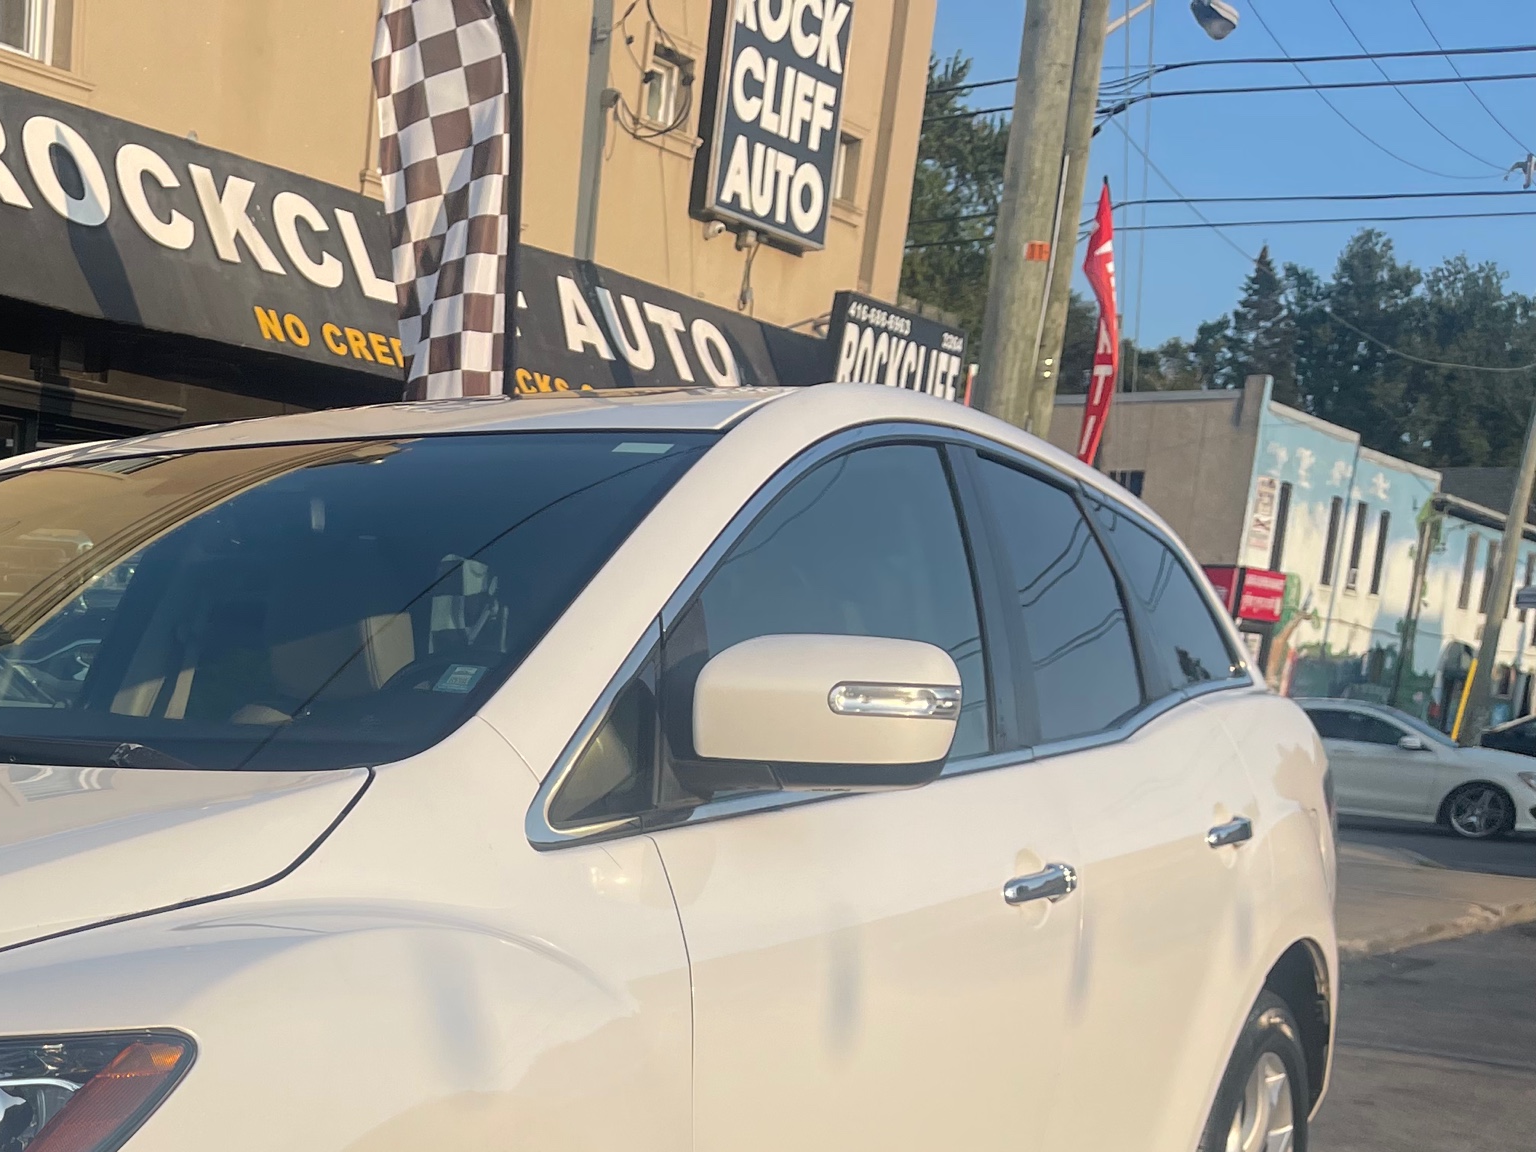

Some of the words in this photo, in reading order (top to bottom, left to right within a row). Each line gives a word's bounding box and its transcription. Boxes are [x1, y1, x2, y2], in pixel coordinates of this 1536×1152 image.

[732, 46, 837, 152] CLIFF
[720, 134, 825, 234] AUTO
[253, 305, 311, 347] NO
[556, 275, 741, 387] AUTO
